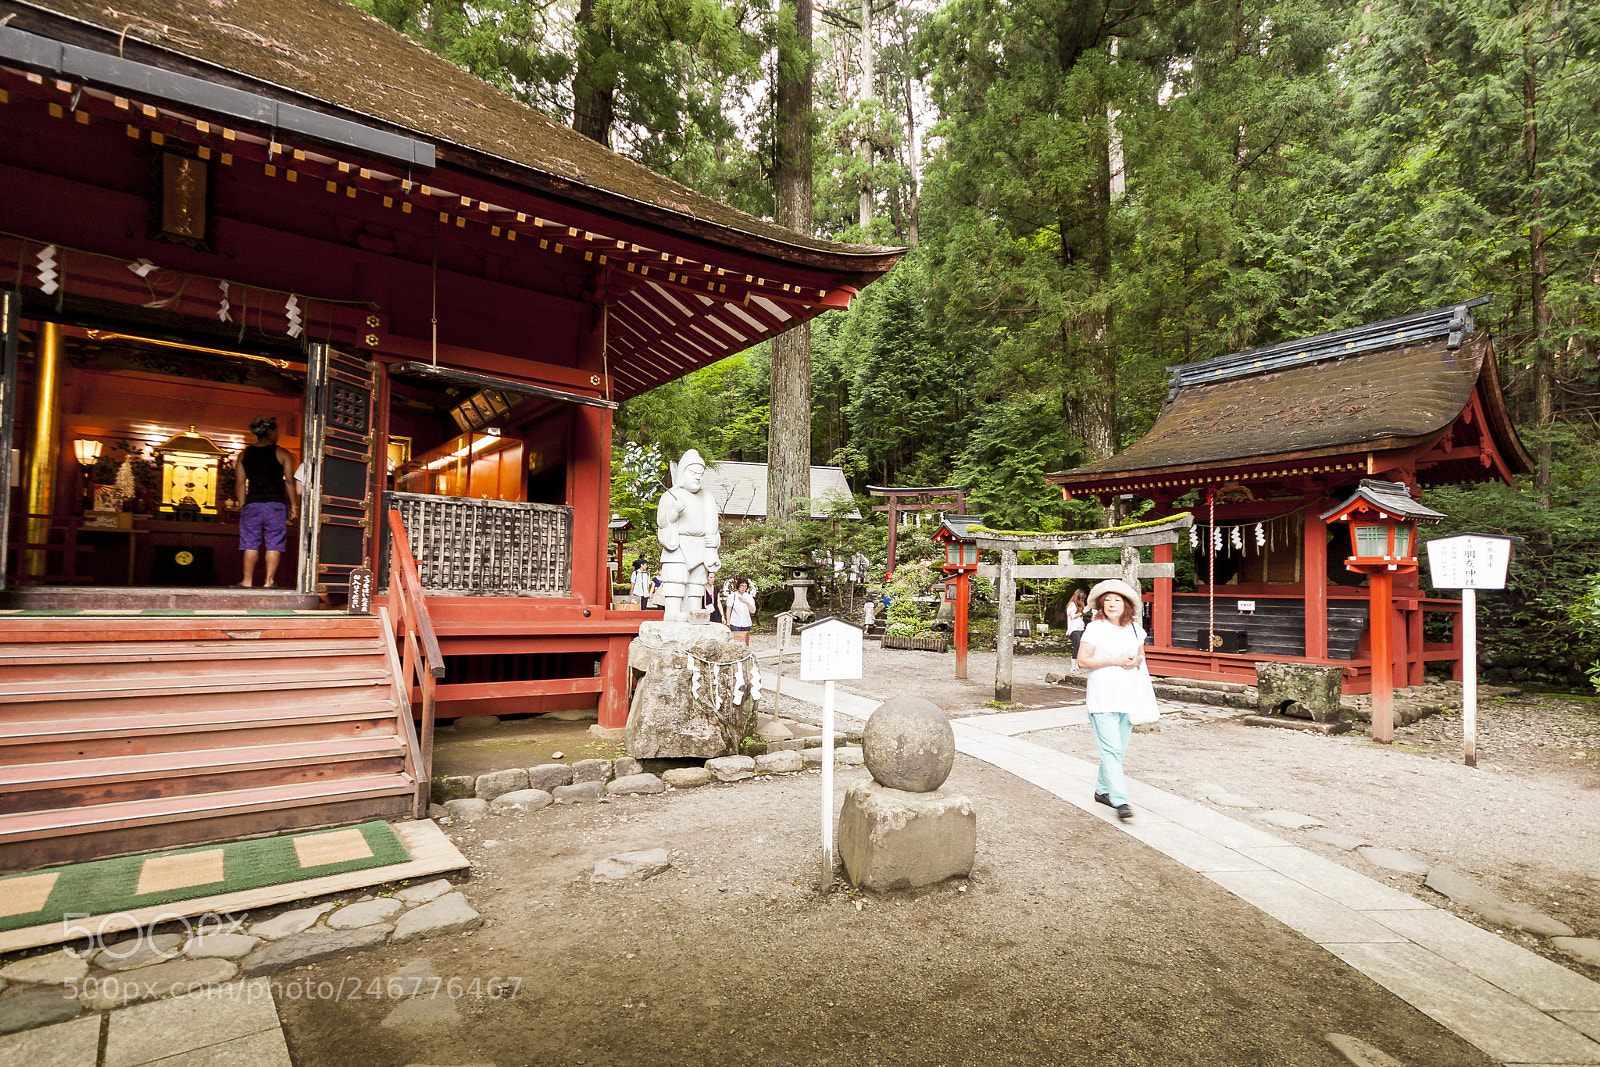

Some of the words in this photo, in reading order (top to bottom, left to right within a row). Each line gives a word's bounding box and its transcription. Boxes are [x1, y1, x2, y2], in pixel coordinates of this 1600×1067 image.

[352, 575, 361, 609] お入りください
